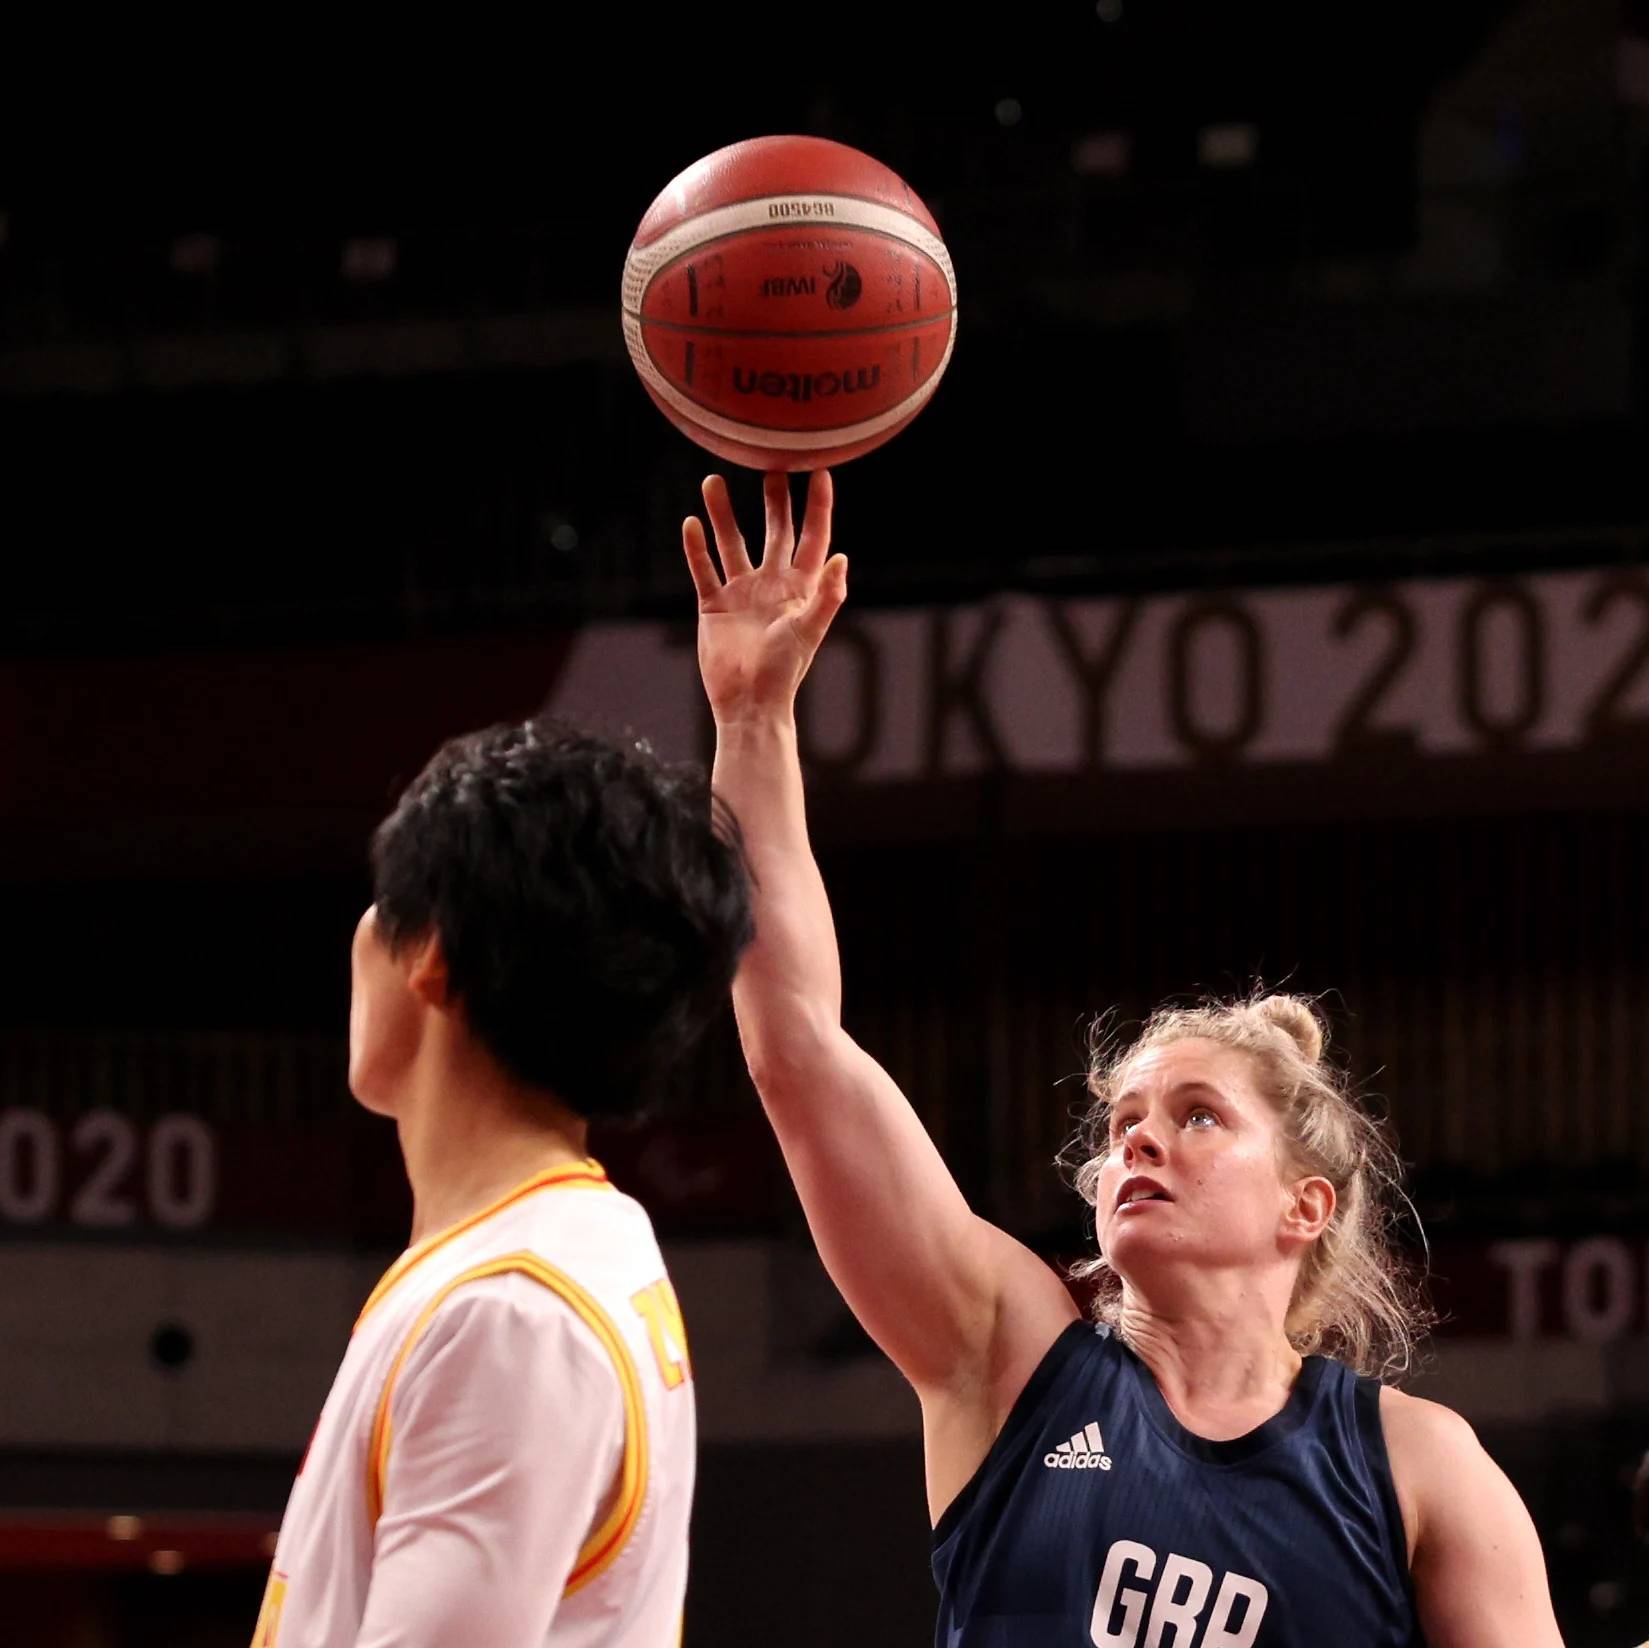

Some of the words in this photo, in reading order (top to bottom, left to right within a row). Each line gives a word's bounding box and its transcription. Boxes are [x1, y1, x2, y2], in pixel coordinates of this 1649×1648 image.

[761, 277, 817, 297] IWBF
[732, 364, 880, 402] molten
[664, 588, 1266, 778] OKYO
[1044, 1450, 1112, 1471] adidas
